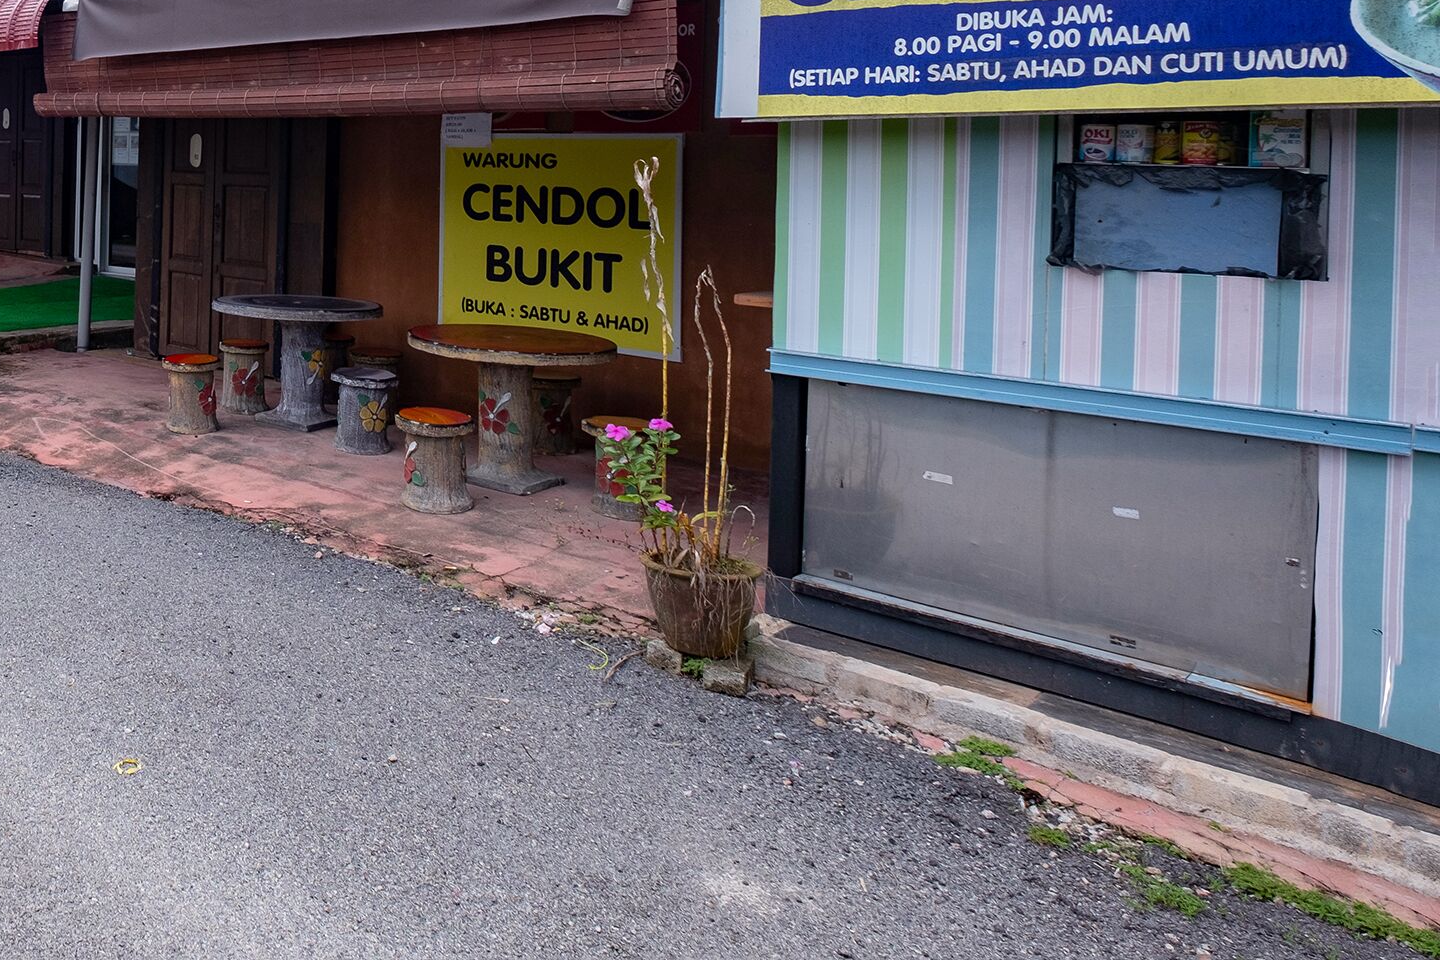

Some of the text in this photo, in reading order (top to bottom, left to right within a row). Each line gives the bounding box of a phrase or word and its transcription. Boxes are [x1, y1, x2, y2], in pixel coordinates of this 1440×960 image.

[956, 3, 1114, 32] DIBUKA JAM:
[893, 34, 941, 57] 8.00
[947, 32, 1003, 54] PAGI
[1027, 28, 1081, 51] 9.00
[1088, 21, 1191, 47] MALAM
[789, 44, 1348, 89] (SETIAP HARI: SABTU, AHAD DAN CUTI UMUM)
[1084, 128, 1110, 138] OKI
[462, 152, 558, 170] WARUNG
[462, 183, 650, 230] CENDOL
[486, 244, 624, 294] BUKIT
[461, 296, 507, 317] (BUKA
[519, 304, 571, 324] SABTU
[576, 310, 589, 327] &
[593, 312, 650, 335] AHAD)
